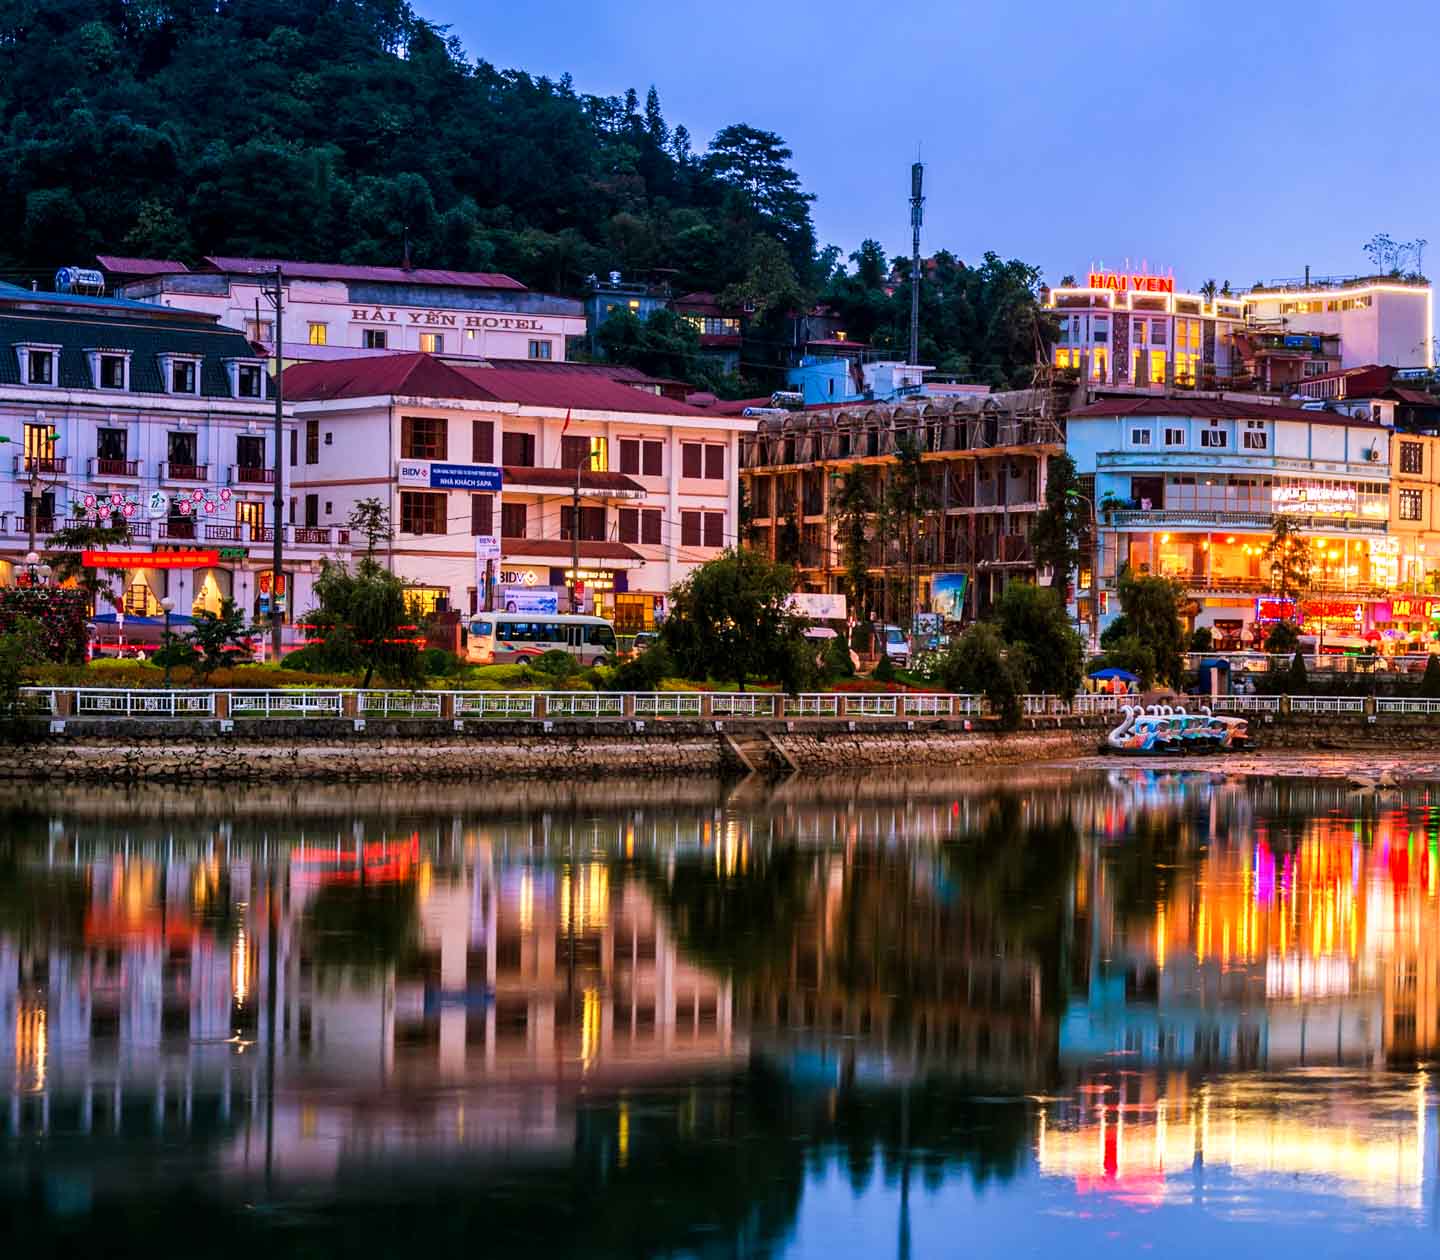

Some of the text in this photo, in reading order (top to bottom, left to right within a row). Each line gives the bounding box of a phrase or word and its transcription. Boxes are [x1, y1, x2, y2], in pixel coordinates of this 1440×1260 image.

[1090, 274, 1174, 292] HAI YEN
[351, 306, 544, 331] HẢI YẾN HOTEL
[402, 467, 421, 476] BIDV
[440, 476, 454, 485] NHÀ
[454, 477, 476, 487] KHÁCH
[500, 571, 526, 585] BIDV
